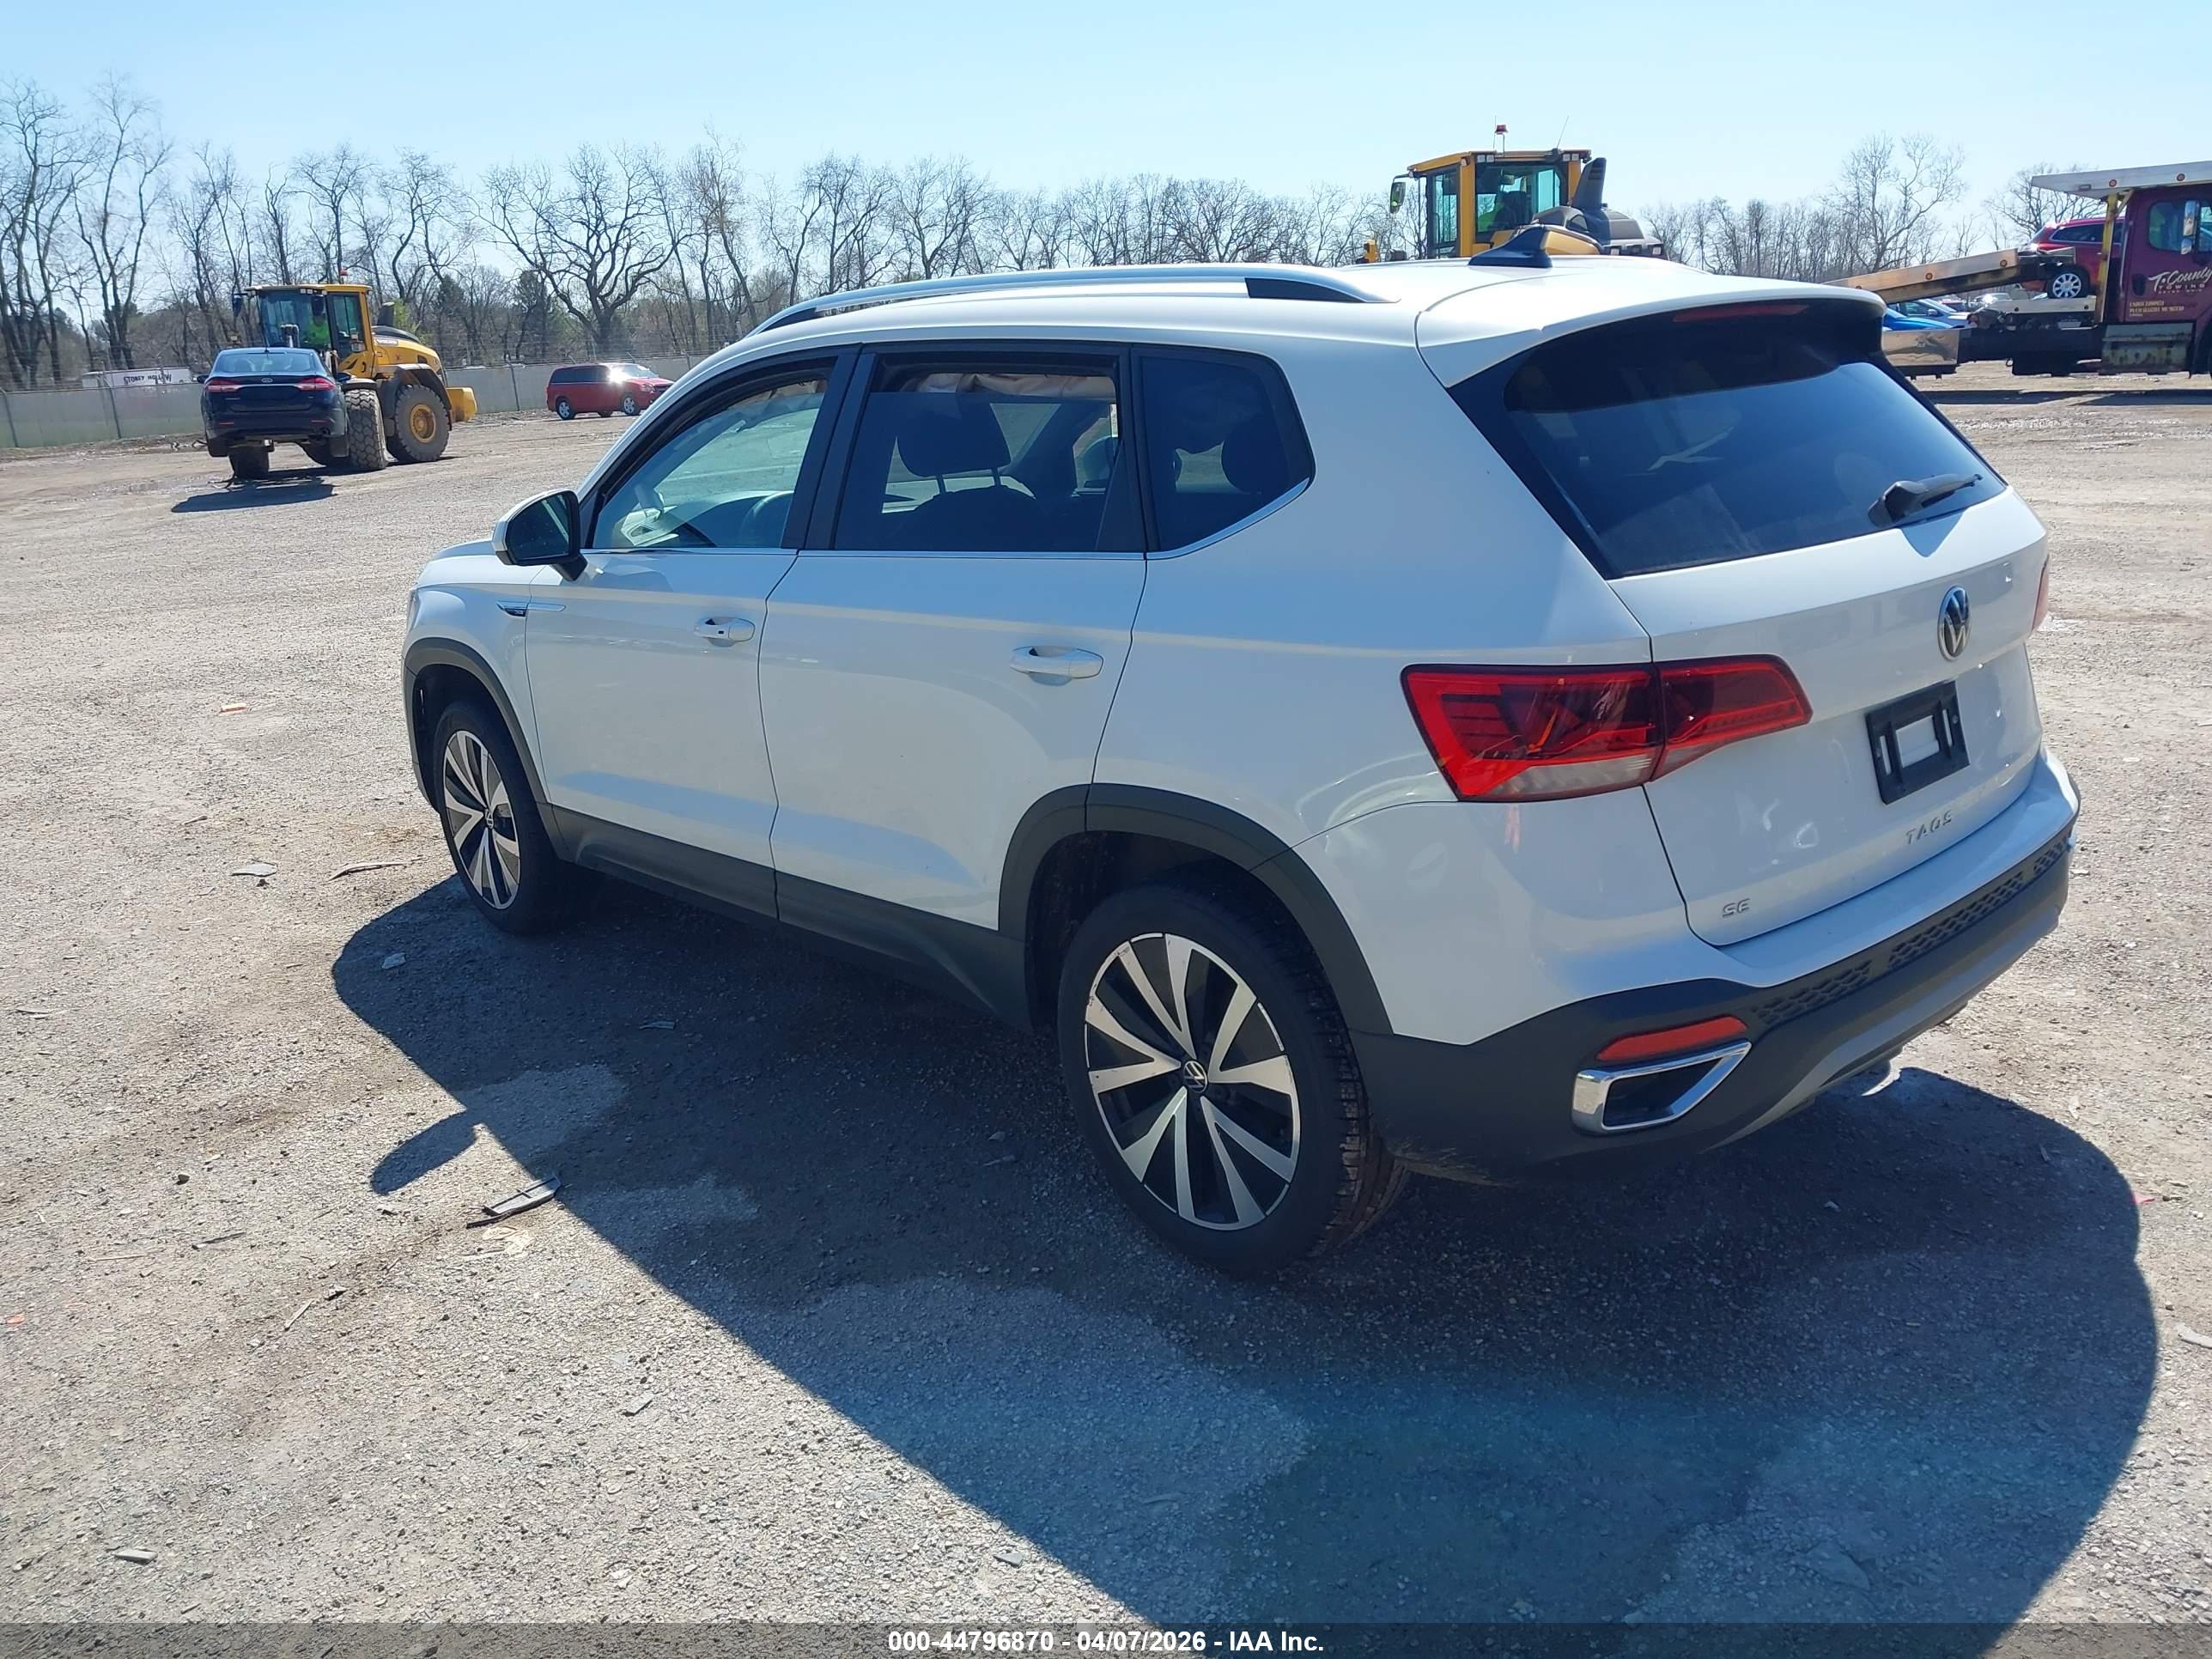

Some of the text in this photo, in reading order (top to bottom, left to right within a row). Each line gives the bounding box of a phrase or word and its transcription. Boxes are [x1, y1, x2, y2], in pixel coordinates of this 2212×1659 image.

[1937, 586, 1972, 662] VW
[1905, 810, 1952, 845] TAOS
[1722, 898, 1751, 918] SE
